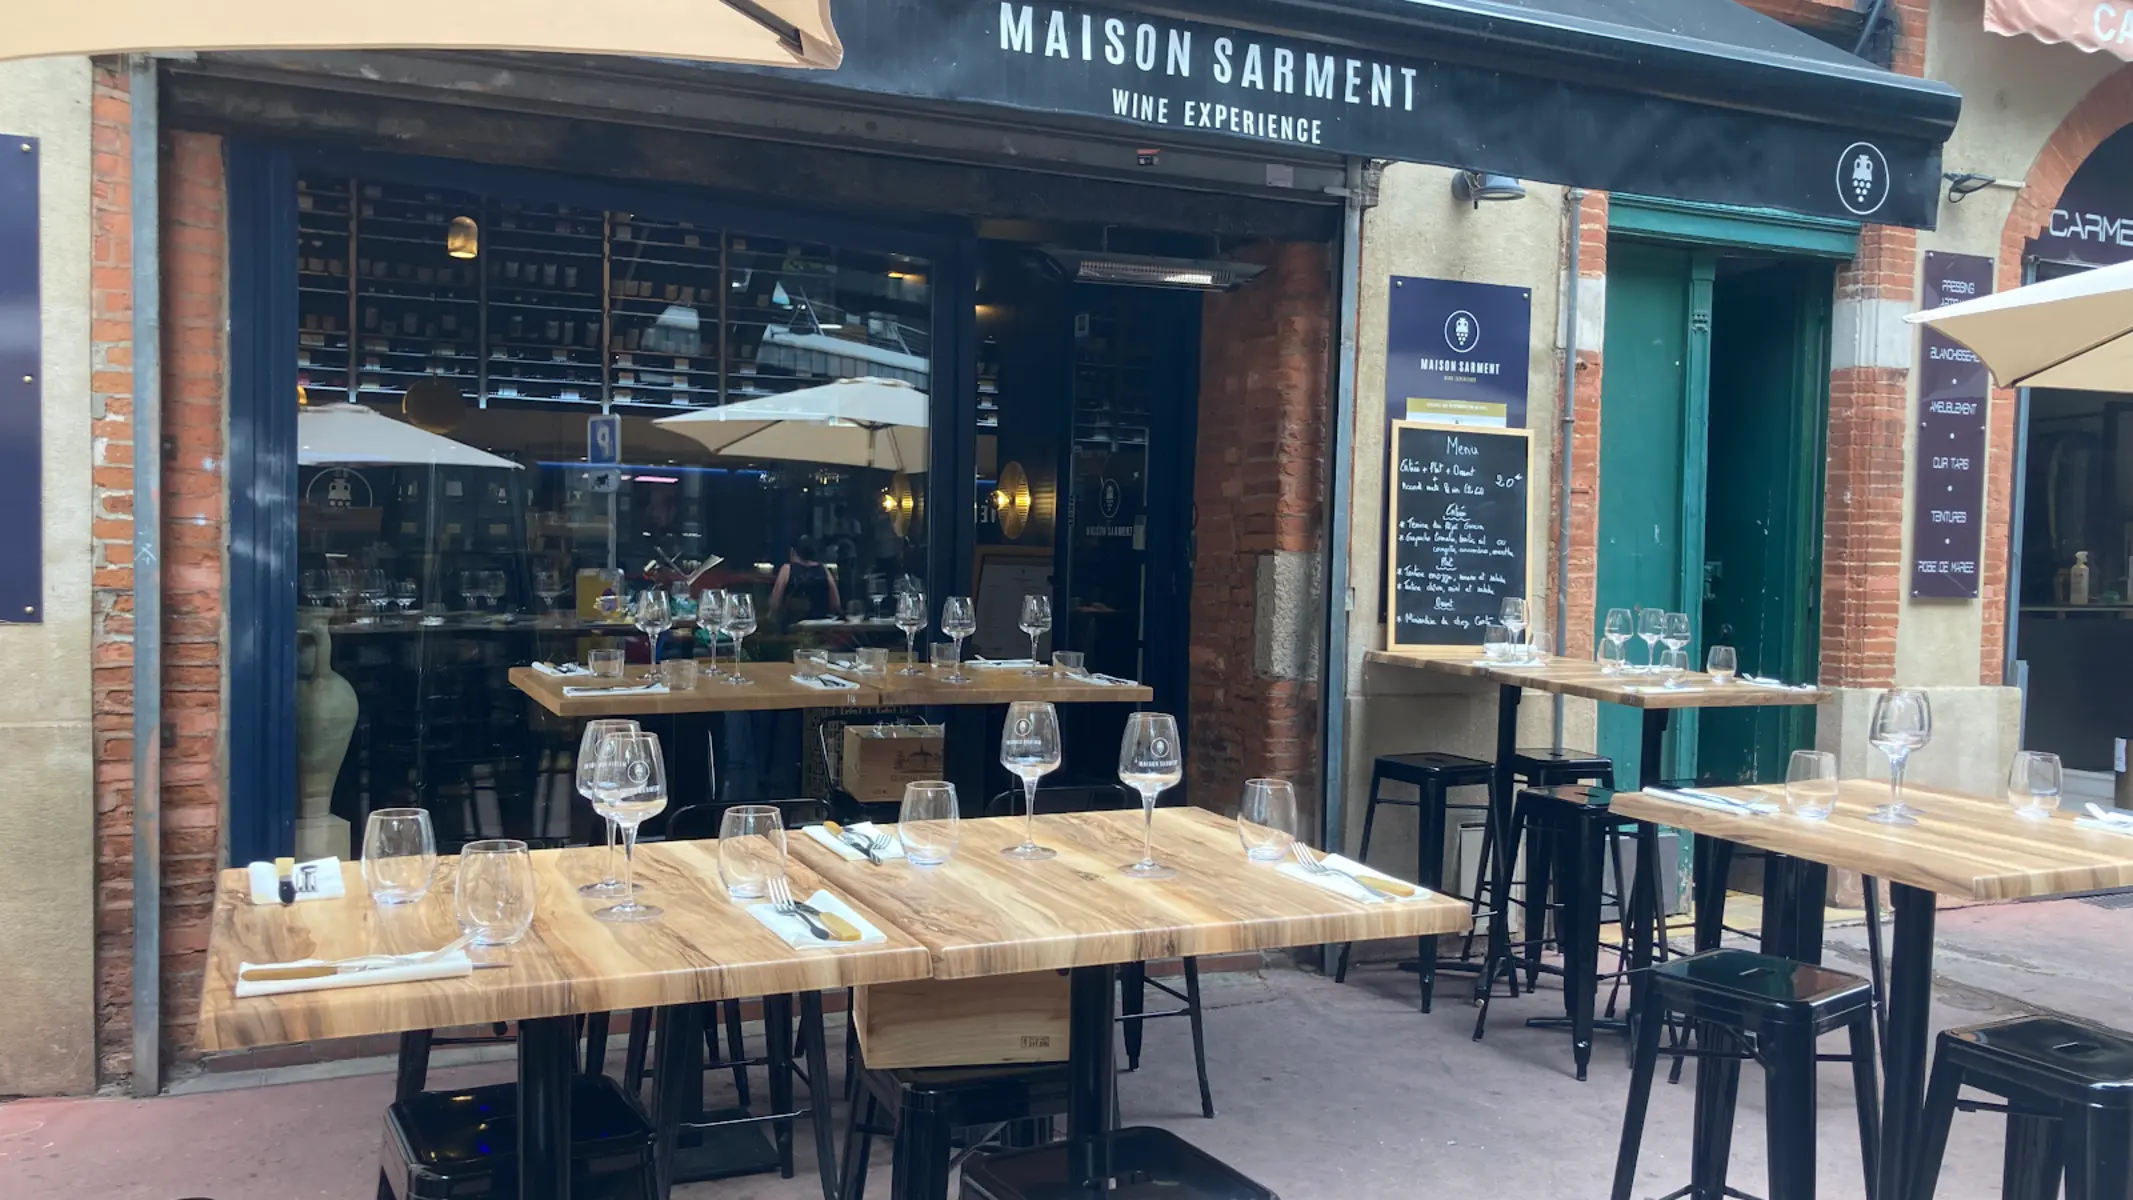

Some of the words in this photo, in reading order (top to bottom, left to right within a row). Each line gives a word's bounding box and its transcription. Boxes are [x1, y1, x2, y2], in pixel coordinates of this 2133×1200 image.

[1000, 3, 1191, 77] MAISON
[1213, 37, 1418, 111] SARMENT
[1112, 88, 1168, 124] WINE
[1184, 100, 1322, 145] EXPERIENCE
[1941, 279, 1975, 294] PRESSING
[1420, 358, 1456, 372] MAISON
[1459, 361, 1500, 375] SARMENT
[1446, 436, 1479, 455] Menu
[1930, 510, 1967, 523] TENTURES
[1918, 560, 1937, 573] ROBE
[1938, 561, 1949, 573] DE
